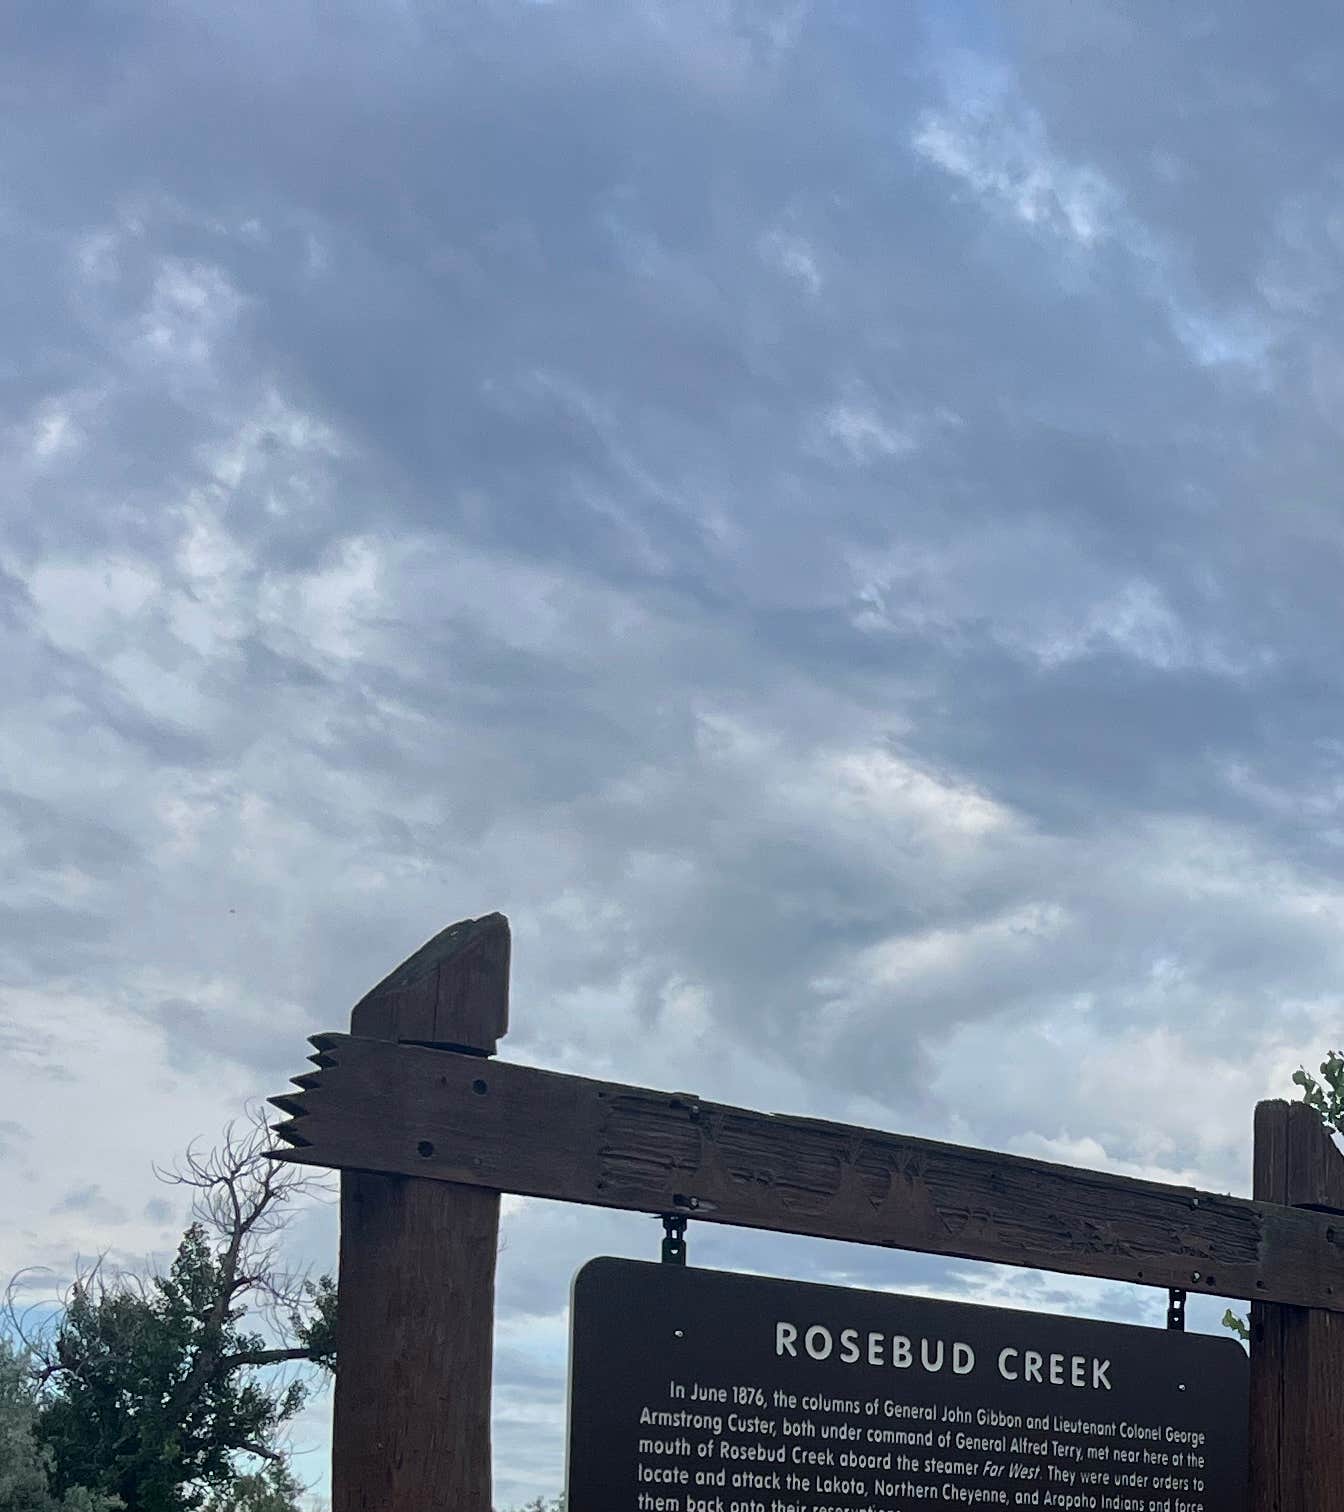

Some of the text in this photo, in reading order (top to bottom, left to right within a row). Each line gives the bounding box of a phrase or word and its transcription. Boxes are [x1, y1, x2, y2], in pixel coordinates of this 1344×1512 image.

[776, 1322, 1112, 1390] ROSEBUD CREEK
[639, 1406, 1169, 1466] Armstrong Custer, both under command General Alfred Terry, met near here
[690, 1382, 1205, 1449] June 1876, columns General John Gibbon and Lieutenant Colonel George
[638, 1436, 1189, 1491] mouth Rosebud Creek aboard steamer Far West. They were under orders
[638, 1462, 689, 1485] locate
[695, 1467, 726, 1487] and
[731, 1470, 781, 1490] attack
[816, 1475, 869, 1498] Lakota,
[874, 1478, 939, 1499] Northern
[942, 1482, 1010, 1506] Cheyenne,
[1014, 1489, 1040, 1505] and
[1043, 1489, 1097, 1511] Arapaho
[1101, 1494, 1145, 1512] Indians
[1148, 1497, 1171, 1512] and
[637, 1491, 680, 1512] them
